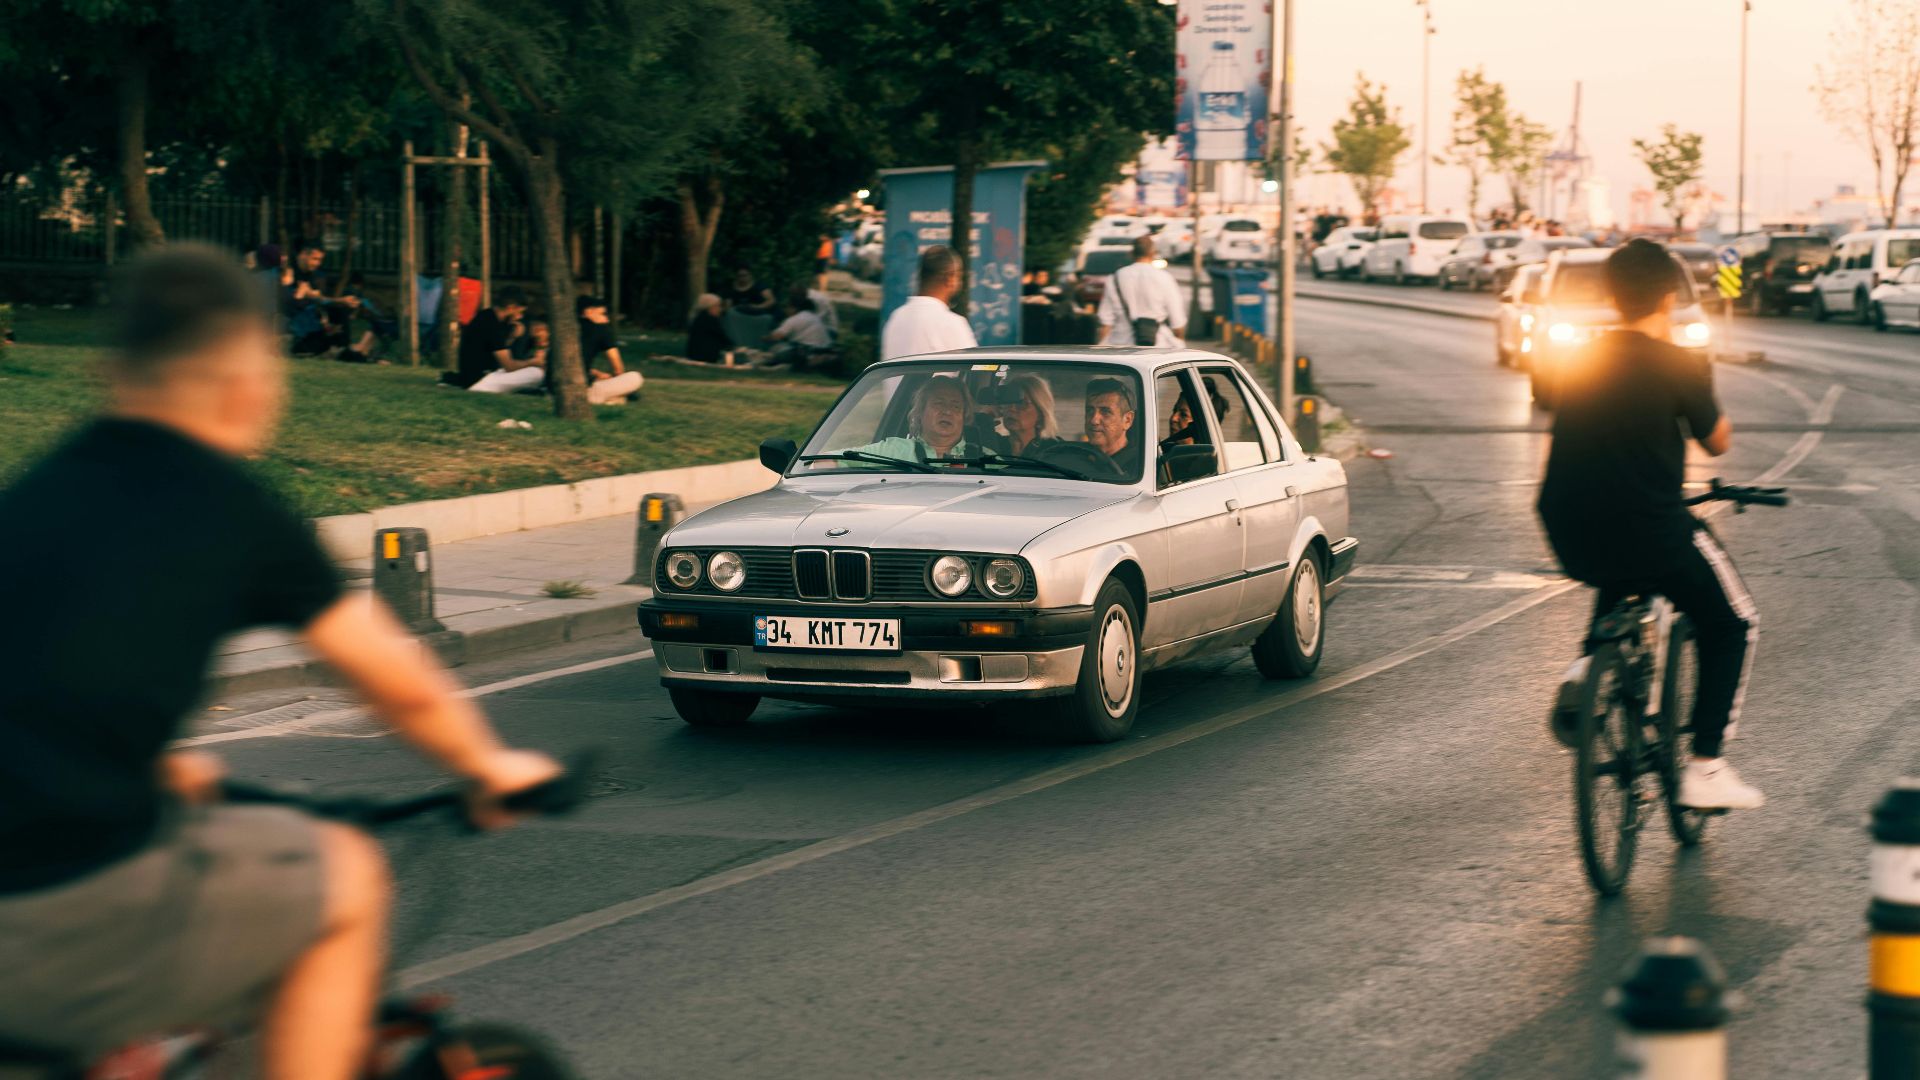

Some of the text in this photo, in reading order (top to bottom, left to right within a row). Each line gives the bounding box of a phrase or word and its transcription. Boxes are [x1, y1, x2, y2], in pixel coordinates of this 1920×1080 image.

[756, 632, 766, 640] TR
[767, 619, 895, 647] 34 KMT 774
